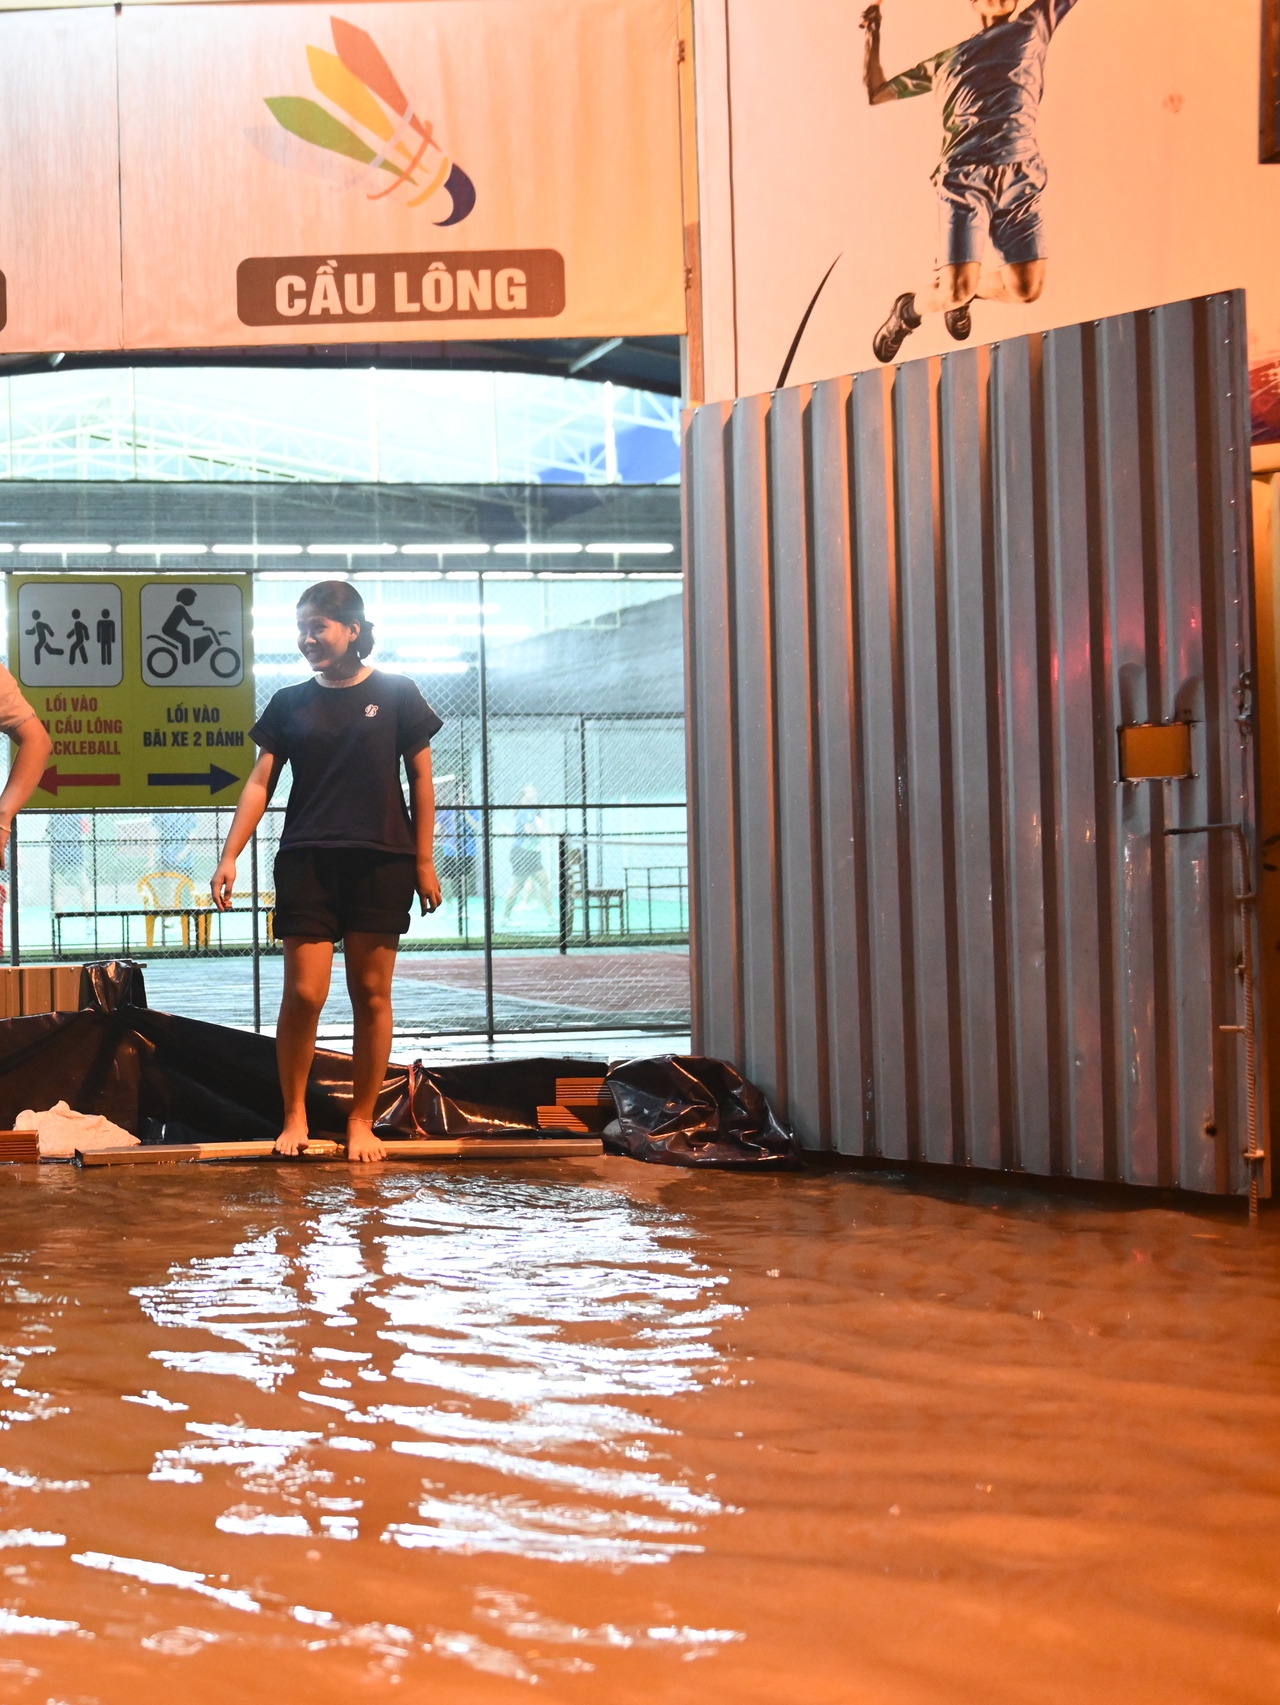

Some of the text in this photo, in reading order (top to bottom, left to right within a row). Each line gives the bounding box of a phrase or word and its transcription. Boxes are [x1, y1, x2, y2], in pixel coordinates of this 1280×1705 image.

[275, 259, 527, 317] CẦU LÔNG
[45, 692, 98, 712] LỐI VÀO
[166, 701, 221, 724] LỐI VÀO
[55, 714, 83, 734] CẦU
[86, 716, 123, 734] LÔNG
[143, 727, 244, 747] BÃI XE 2 BÁNH
